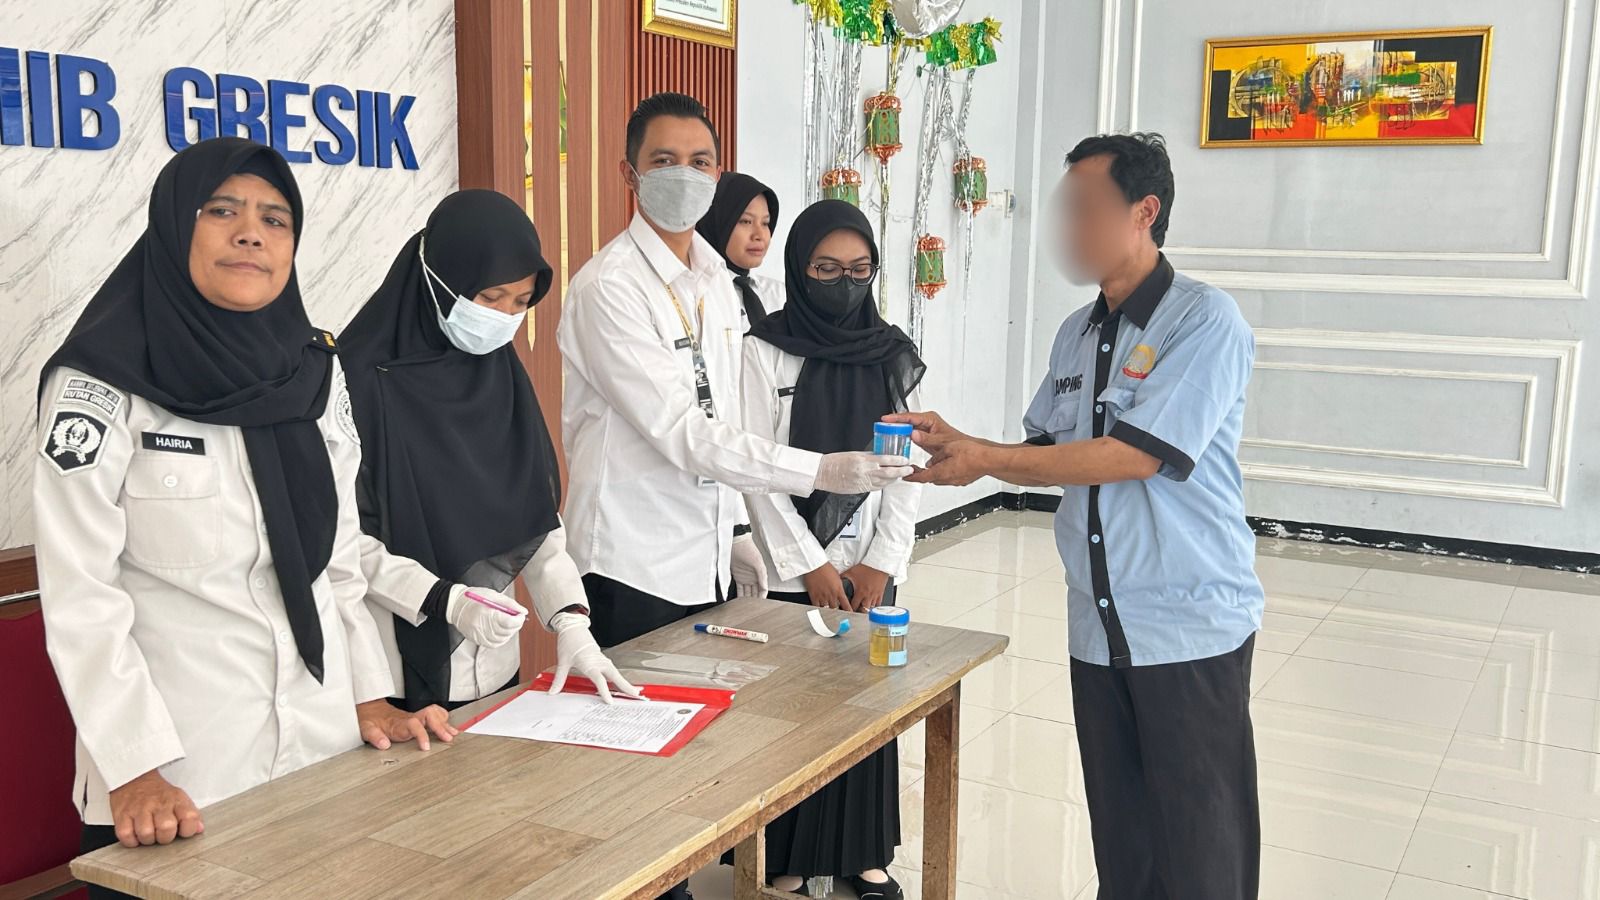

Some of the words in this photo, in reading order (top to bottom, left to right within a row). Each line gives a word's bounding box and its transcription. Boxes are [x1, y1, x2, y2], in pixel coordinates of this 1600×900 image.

[163, 67, 420, 170] GRESIK
[64, 391, 91, 401] RUTAN
[90, 394, 116, 413] GRESIK
[155, 436, 193, 449] HAIRIA
